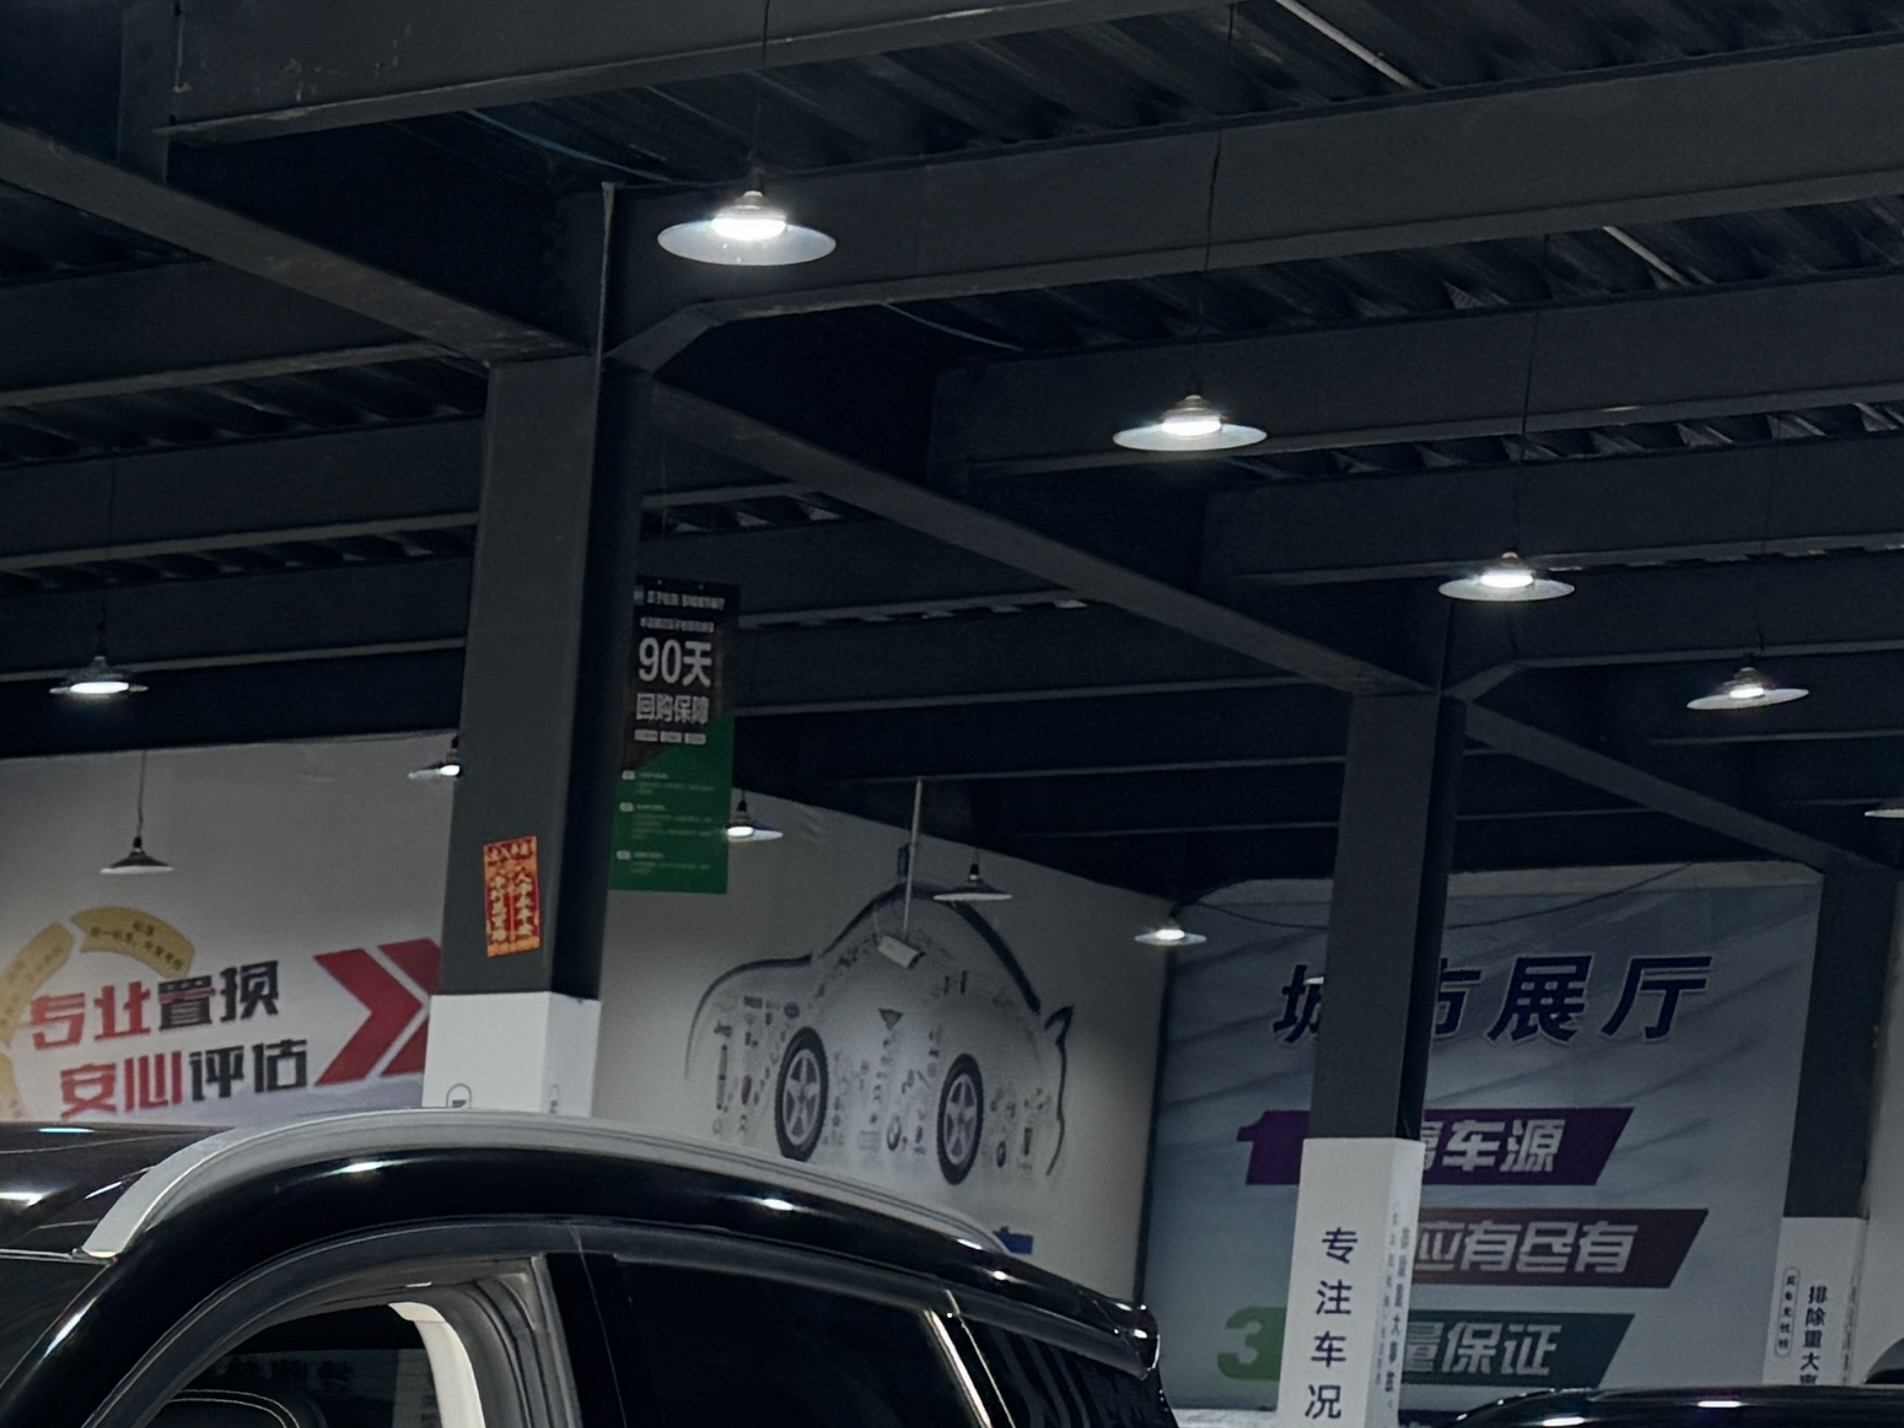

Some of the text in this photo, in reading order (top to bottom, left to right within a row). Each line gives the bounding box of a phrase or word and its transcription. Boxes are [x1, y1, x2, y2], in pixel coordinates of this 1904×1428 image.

[638, 636, 713, 688] 90天
[635, 691, 710, 725] 回购保障
[30, 959, 281, 1051] 专业置换
[59, 1038, 310, 1119] 安心评估
